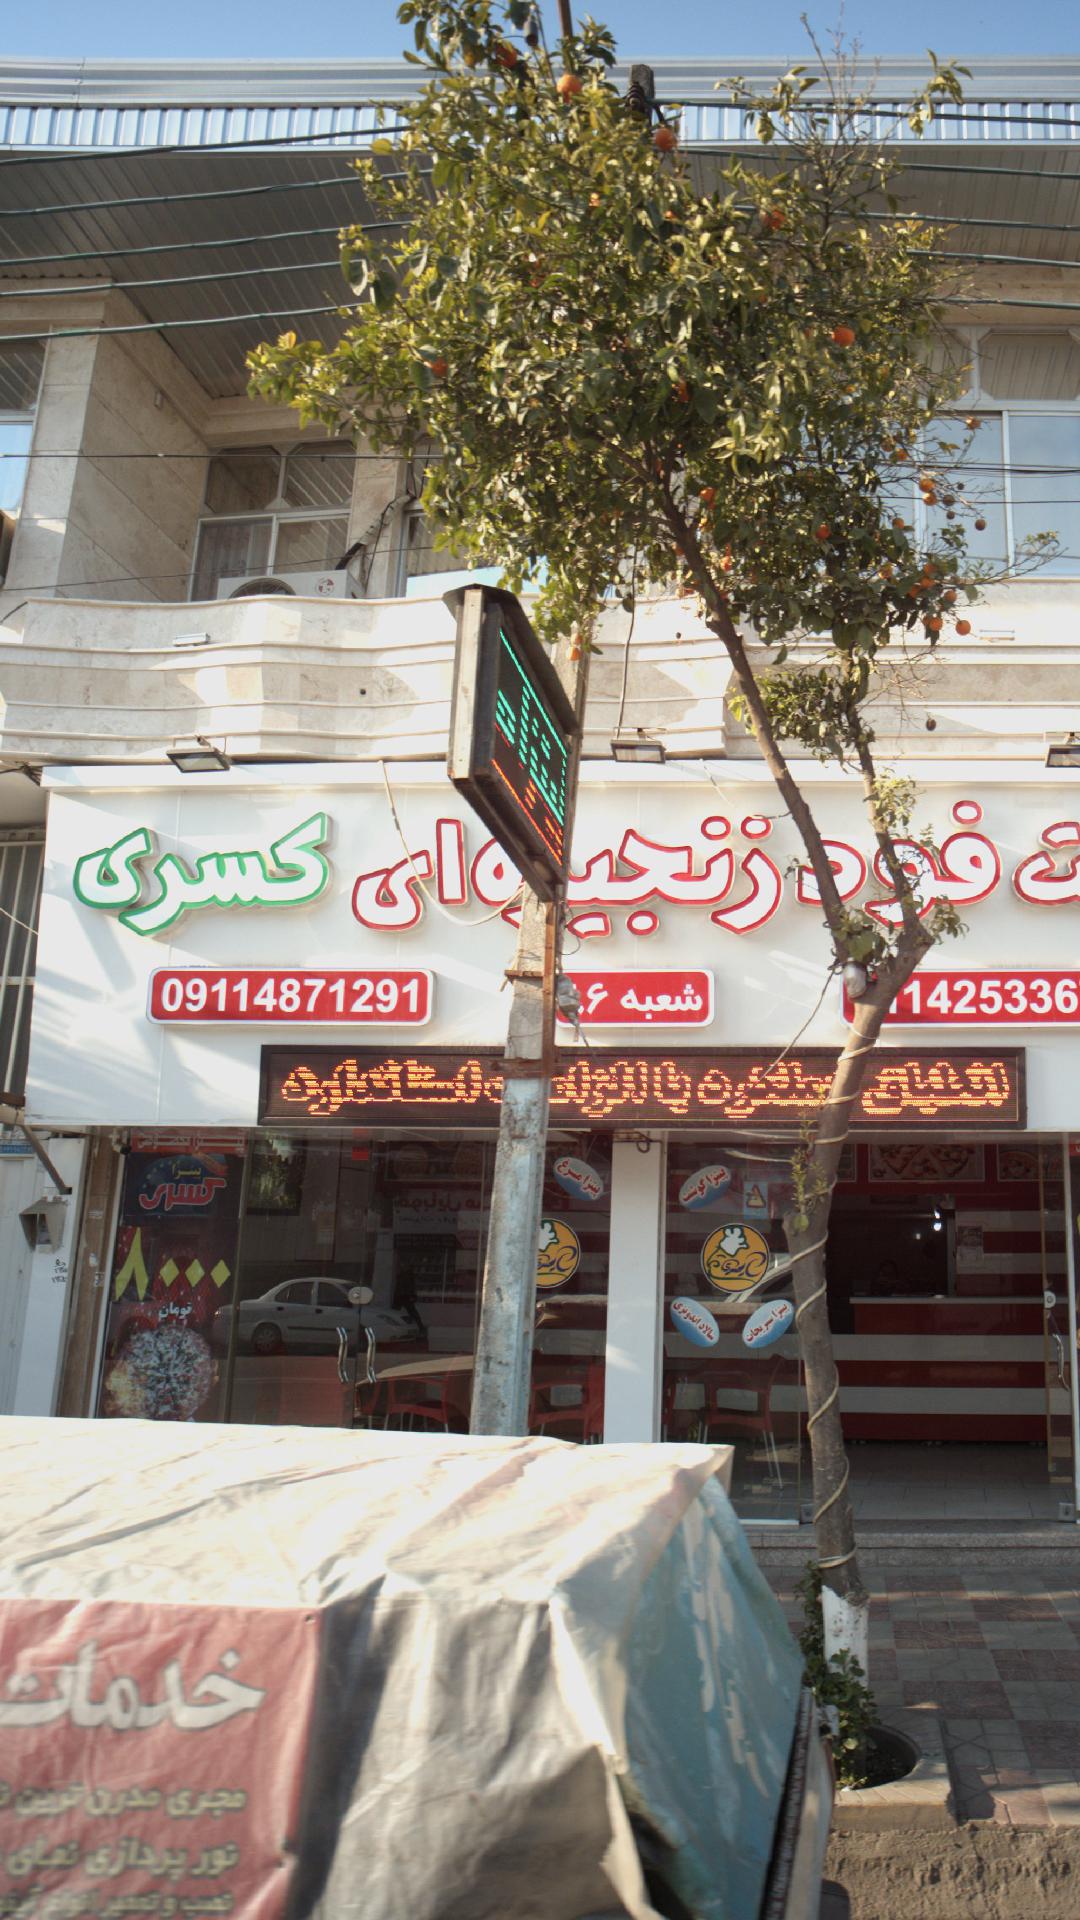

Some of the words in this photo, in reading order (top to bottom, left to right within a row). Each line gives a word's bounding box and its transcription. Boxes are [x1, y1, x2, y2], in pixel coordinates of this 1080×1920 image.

[74, 812, 328, 936] کسری
[162, 978, 419, 1014] 09114871291
[620, 984, 703, 1019] شعبه
[556, 1159, 582, 1181] مرغ
[139, 1177, 226, 1211] کسری
[115, 1226, 231, 1302] ۸۰۰۰
[158, 1302, 193, 1319] تومان
[0, 1640, 266, 1730] خدمات
[15, 1777, 84, 1816] ترین
[85, 1787, 161, 1816] مدرن
[166, 1788, 247, 1820] مجری
[85, 1836, 188, 1882] پردازی
[191, 1841, 240, 1877] نور
